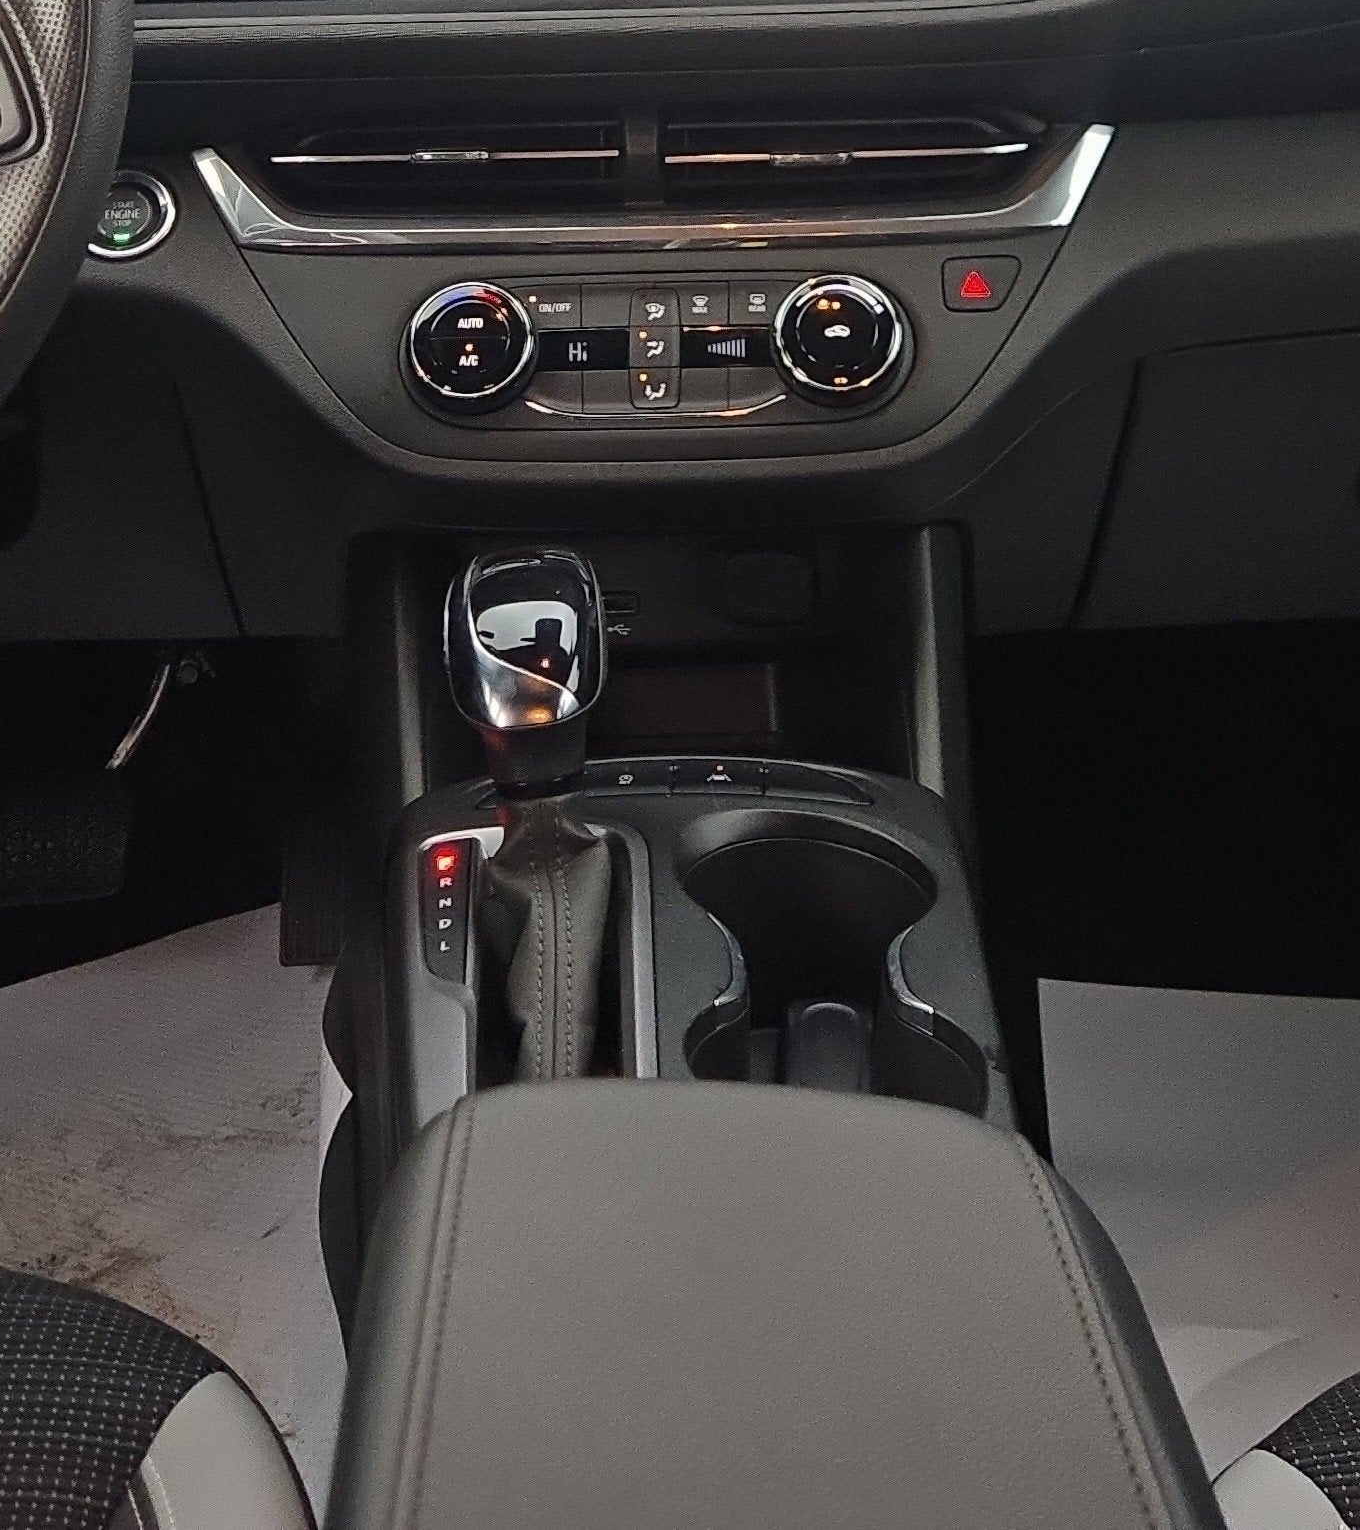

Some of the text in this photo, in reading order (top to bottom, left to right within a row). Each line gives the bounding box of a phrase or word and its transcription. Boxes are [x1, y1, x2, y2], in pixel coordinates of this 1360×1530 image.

[104, 208, 141, 220] ENGINE
[538, 302, 572, 313] ON/OFF
[457, 317, 484, 329] AUTO
[568, 341, 588, 362] Hi
[458, 355, 479, 367] A/C
[440, 877, 452, 887] R
[439, 897, 452, 908] N
[439, 919, 452, 929] D
[440, 941, 450, 951] L
